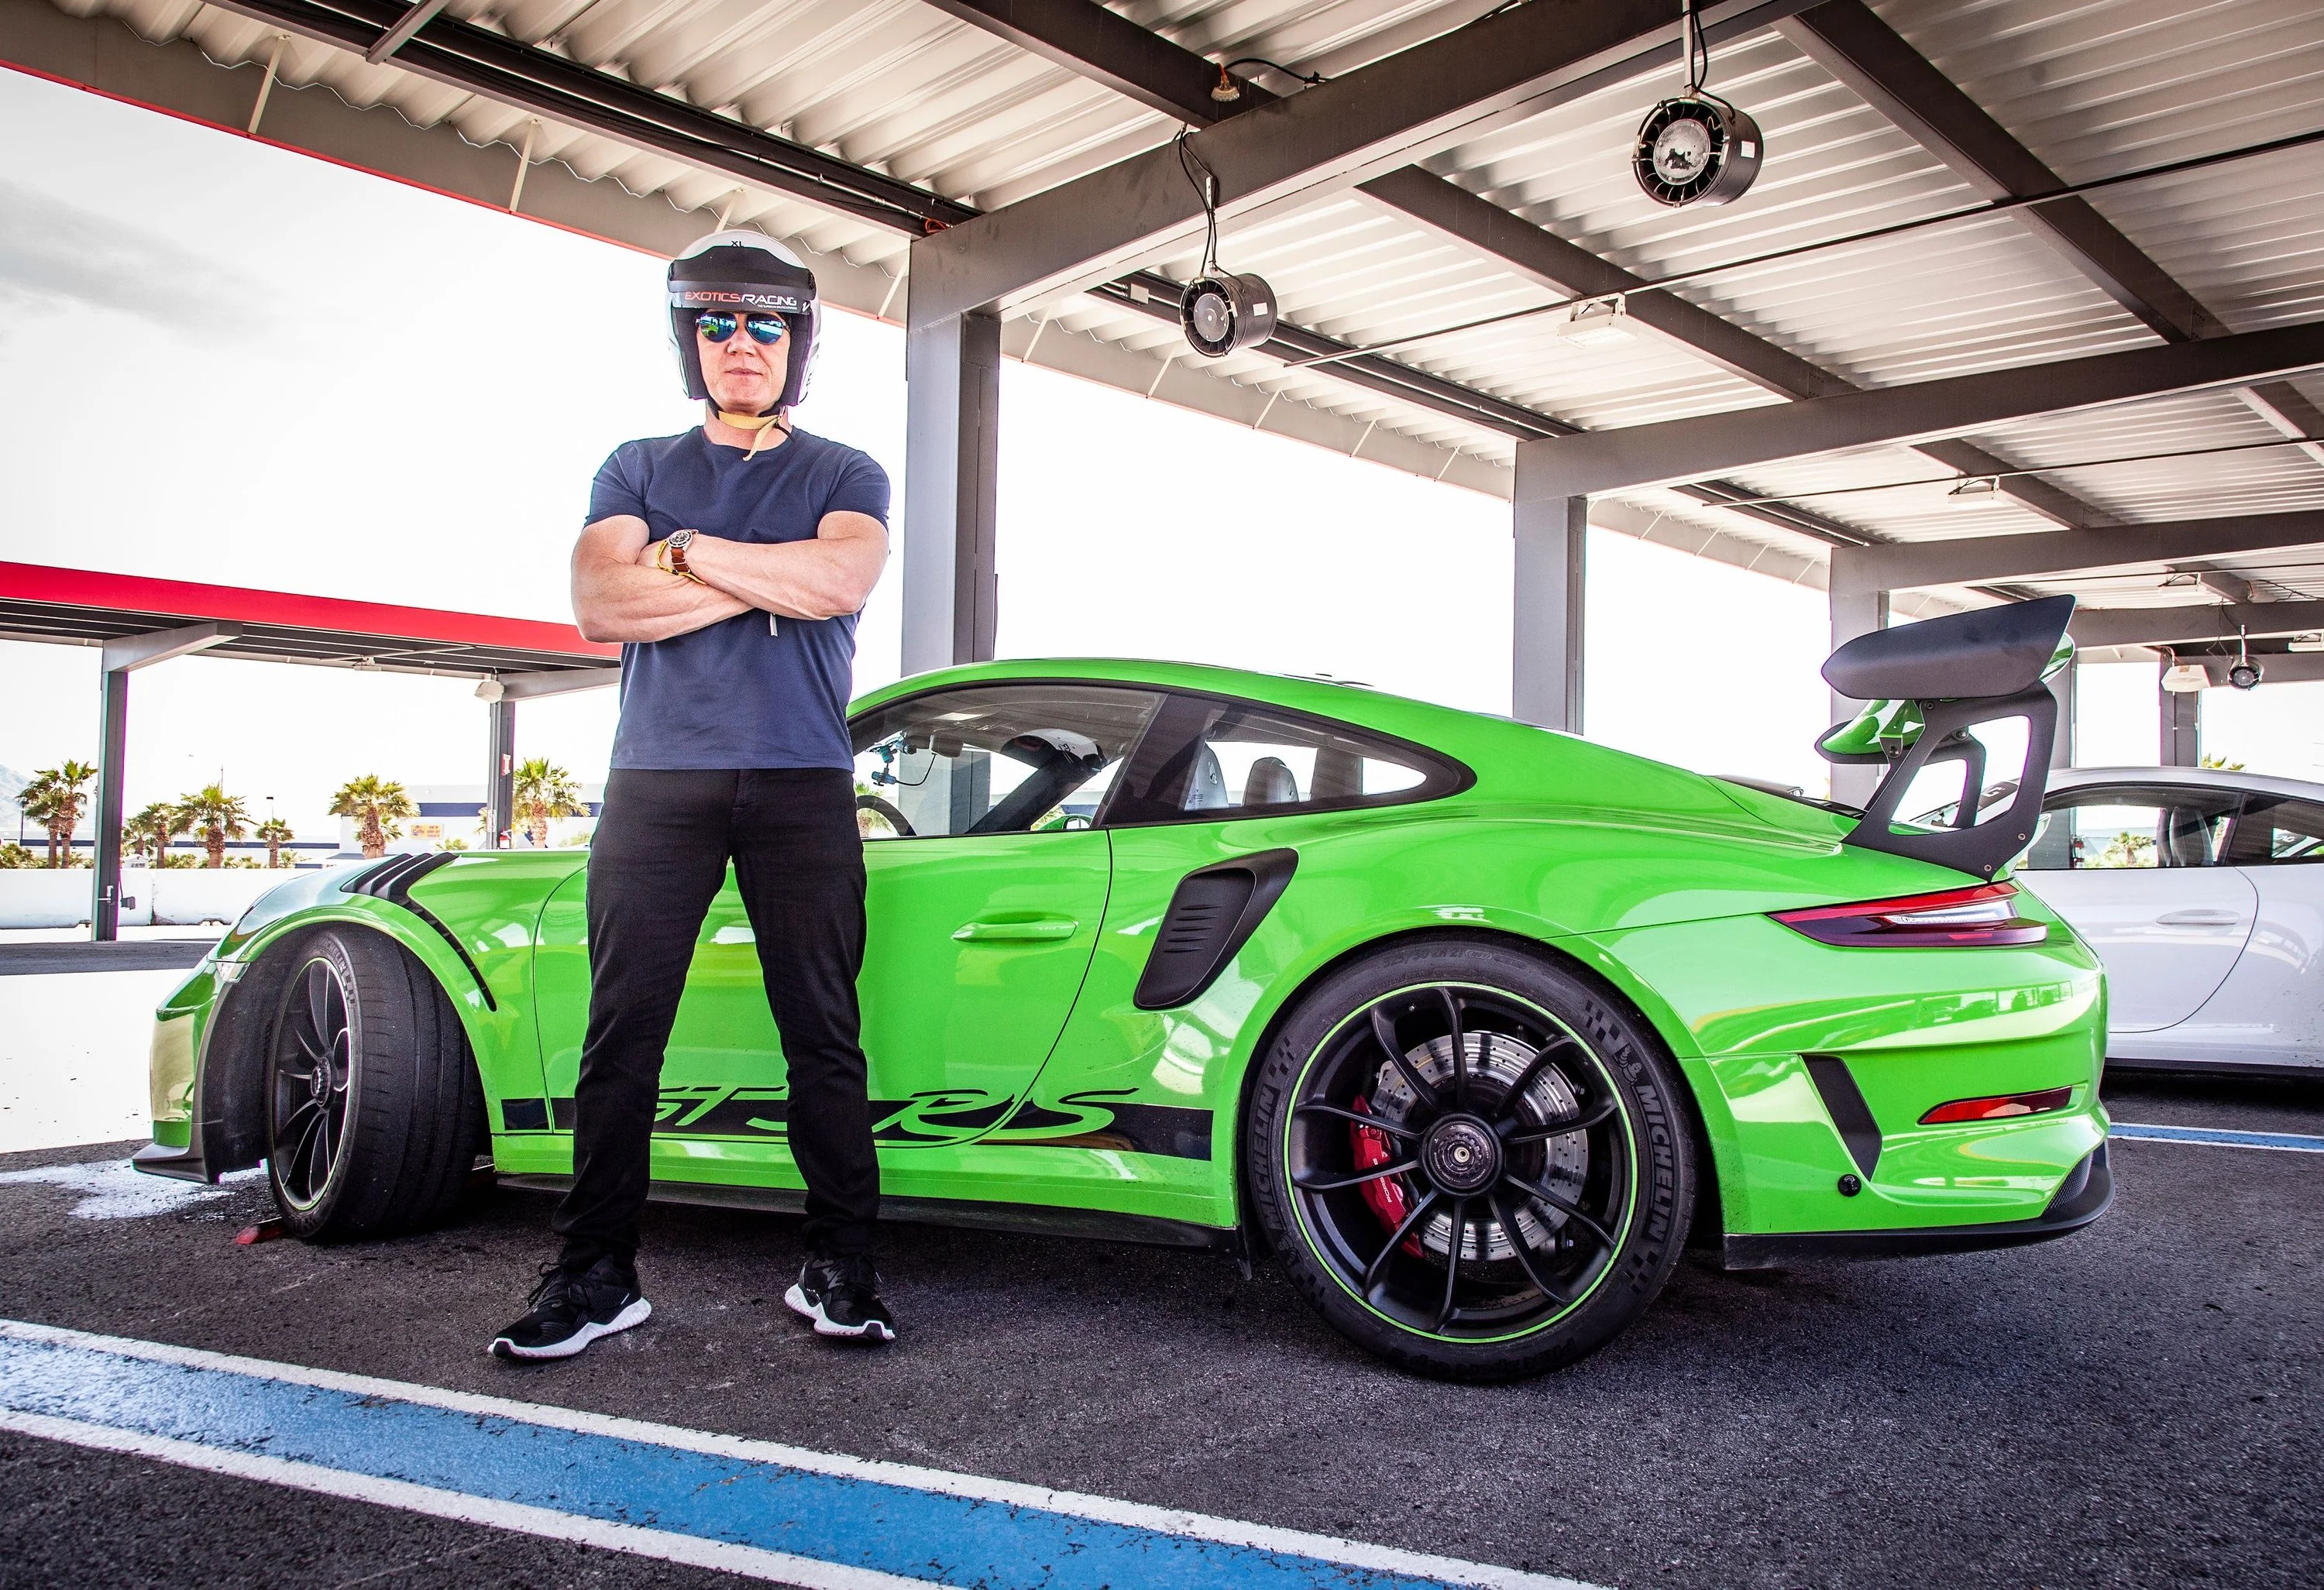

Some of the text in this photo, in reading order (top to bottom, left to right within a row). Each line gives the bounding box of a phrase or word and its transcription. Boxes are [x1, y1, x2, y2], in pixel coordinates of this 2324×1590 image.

[871, 1087, 1140, 1140] RS
[1253, 1085, 1281, 1230] MICHELIN
[1636, 1084, 1673, 1241] MICHELIN
[1373, 1158, 1392, 1203] PORSE
